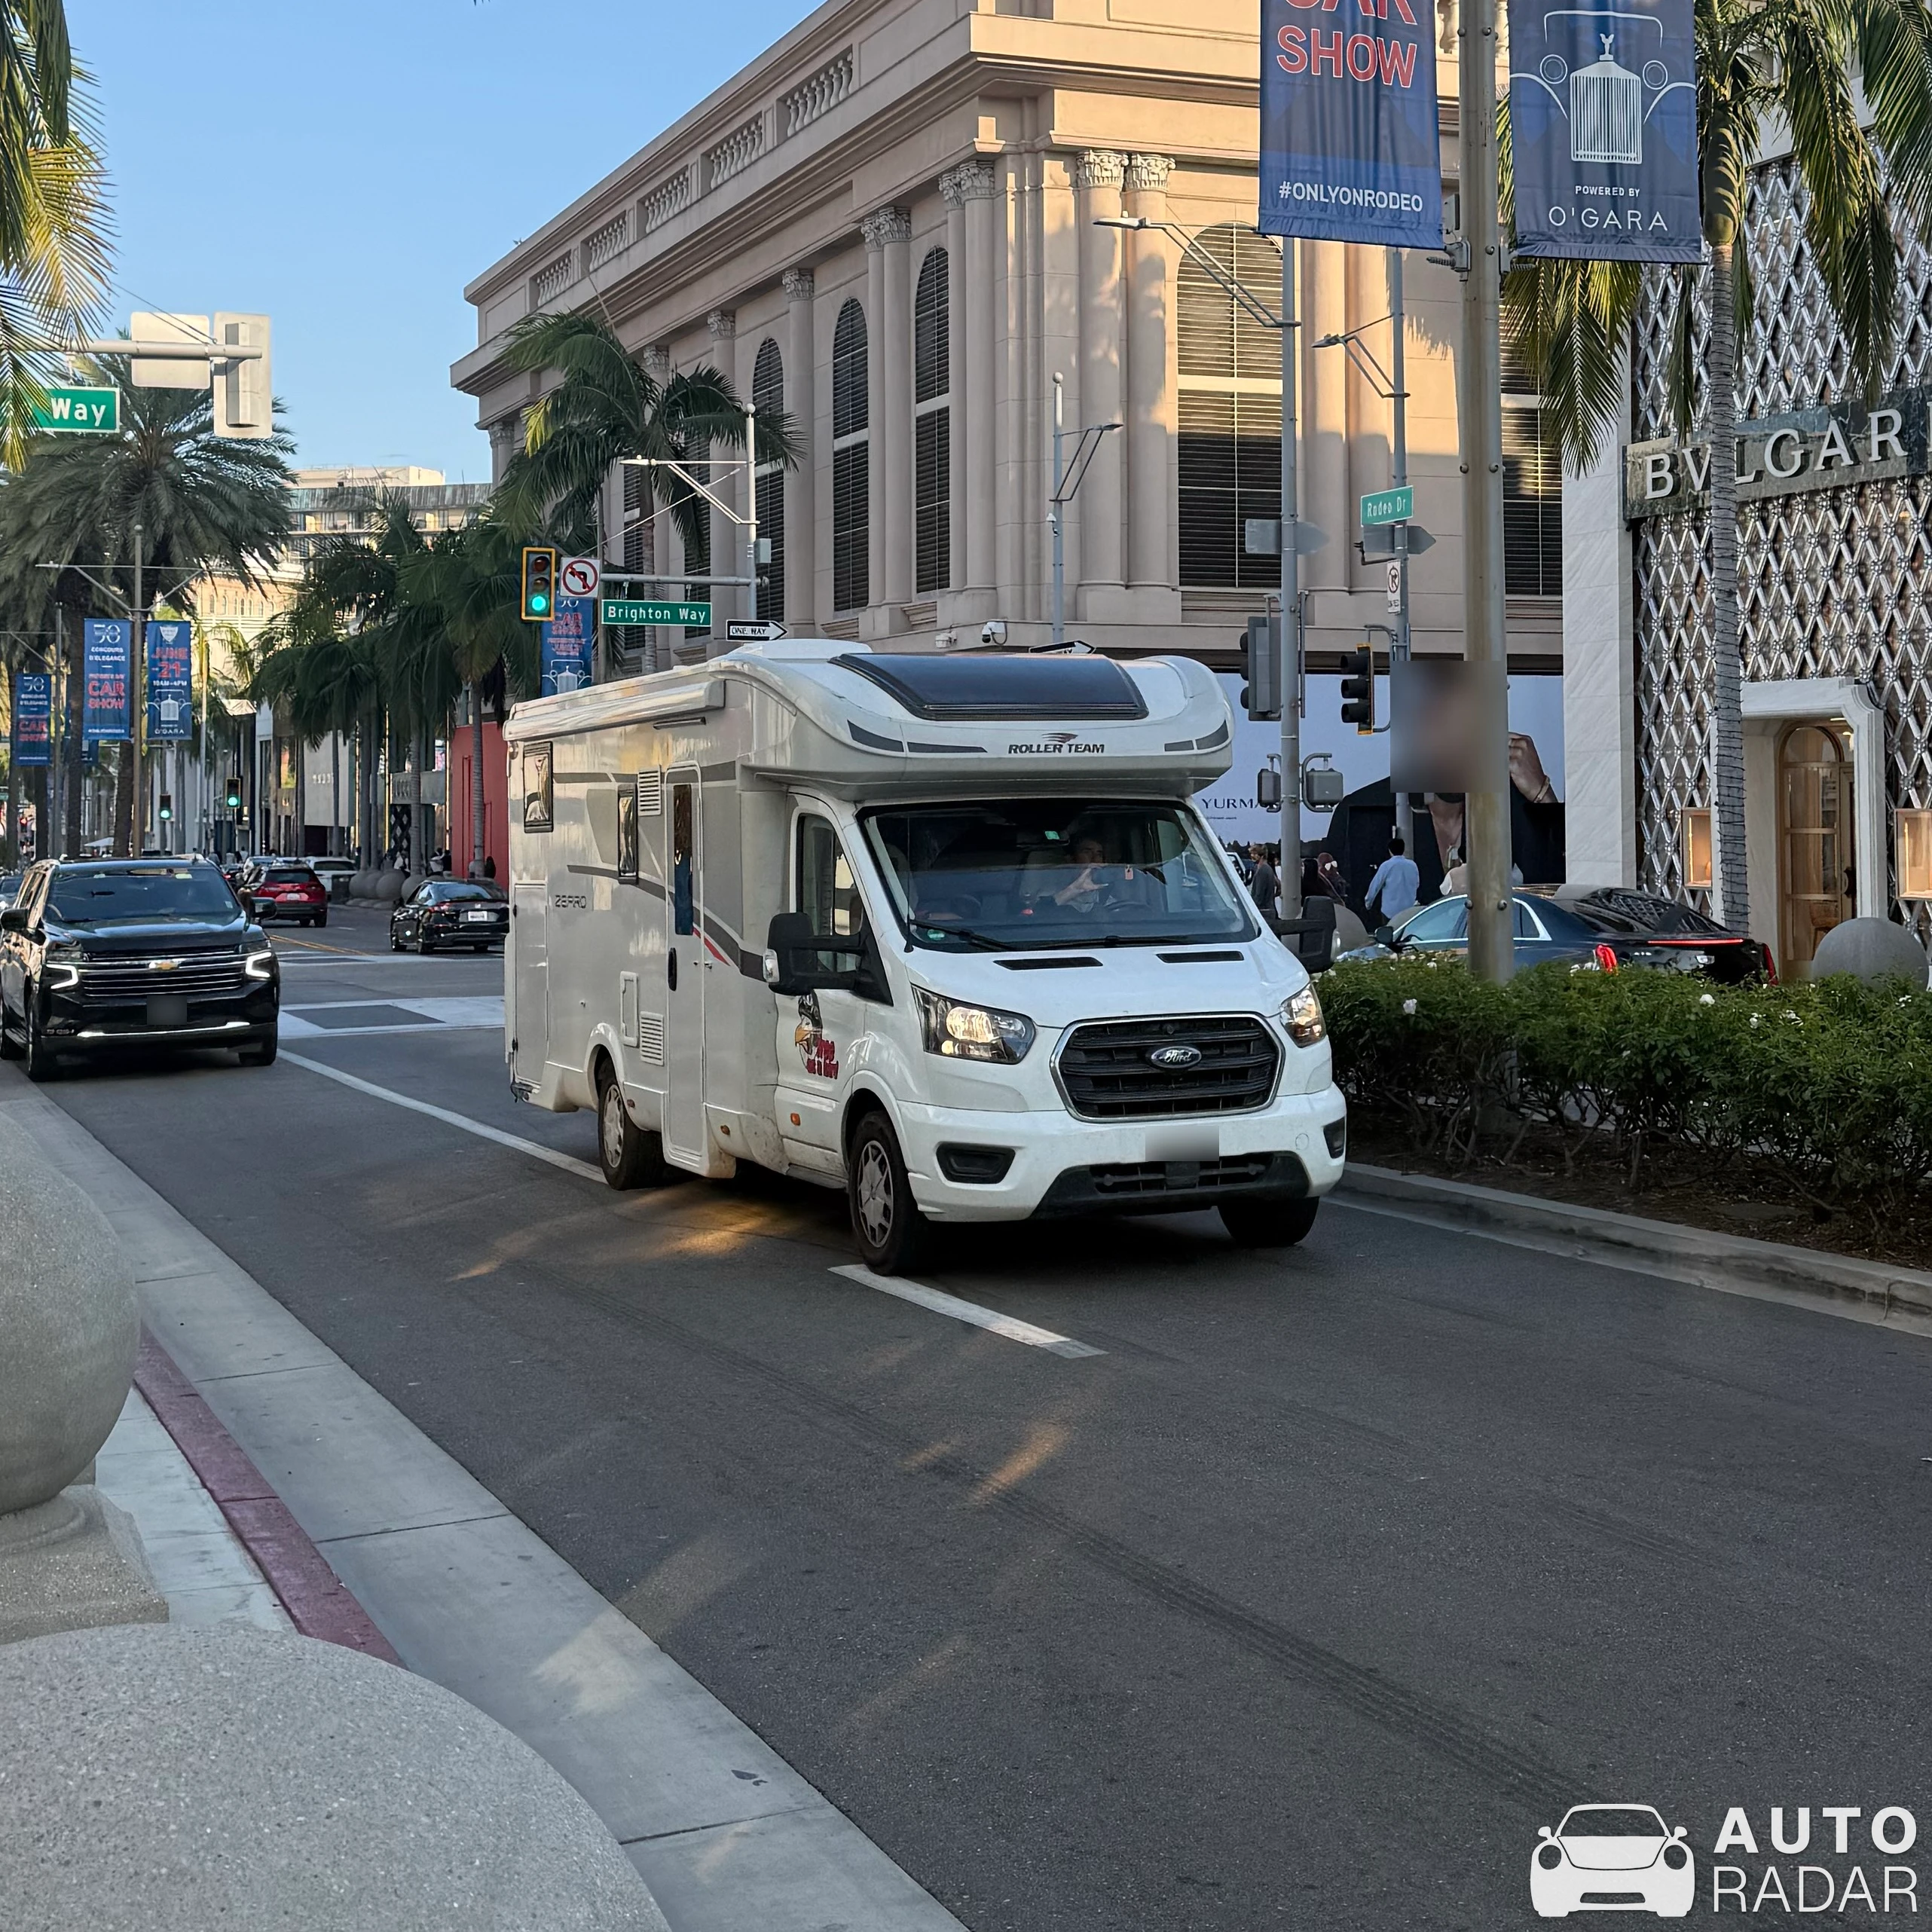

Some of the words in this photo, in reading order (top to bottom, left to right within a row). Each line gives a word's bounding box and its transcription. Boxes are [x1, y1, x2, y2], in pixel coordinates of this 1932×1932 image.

[1276, 25, 1417, 88] SHOW
[1279, 181, 1423, 212] #ONLYONRODEO
[1575, 185, 1625, 196] POWERED
[1628, 188, 1640, 197] BY
[1548, 206, 1668, 231] O'GARA
[50, 397, 106, 427] Way
[1367, 501, 1392, 518] Rodeo
[1396, 496, 1406, 512] Dr
[608, 606, 671, 622] Brighton
[679, 607, 706, 623] Way
[151, 647, 188, 660] JUNE
[87, 680, 126, 697] CAR
[87, 698, 124, 710] SHOW
[1008, 744, 1063, 754] ROLLER
[1067, 744, 1105, 754] TEAM
[1202, 798, 1259, 809] YURM
[1160, 1050, 1192, 1063] Ford
